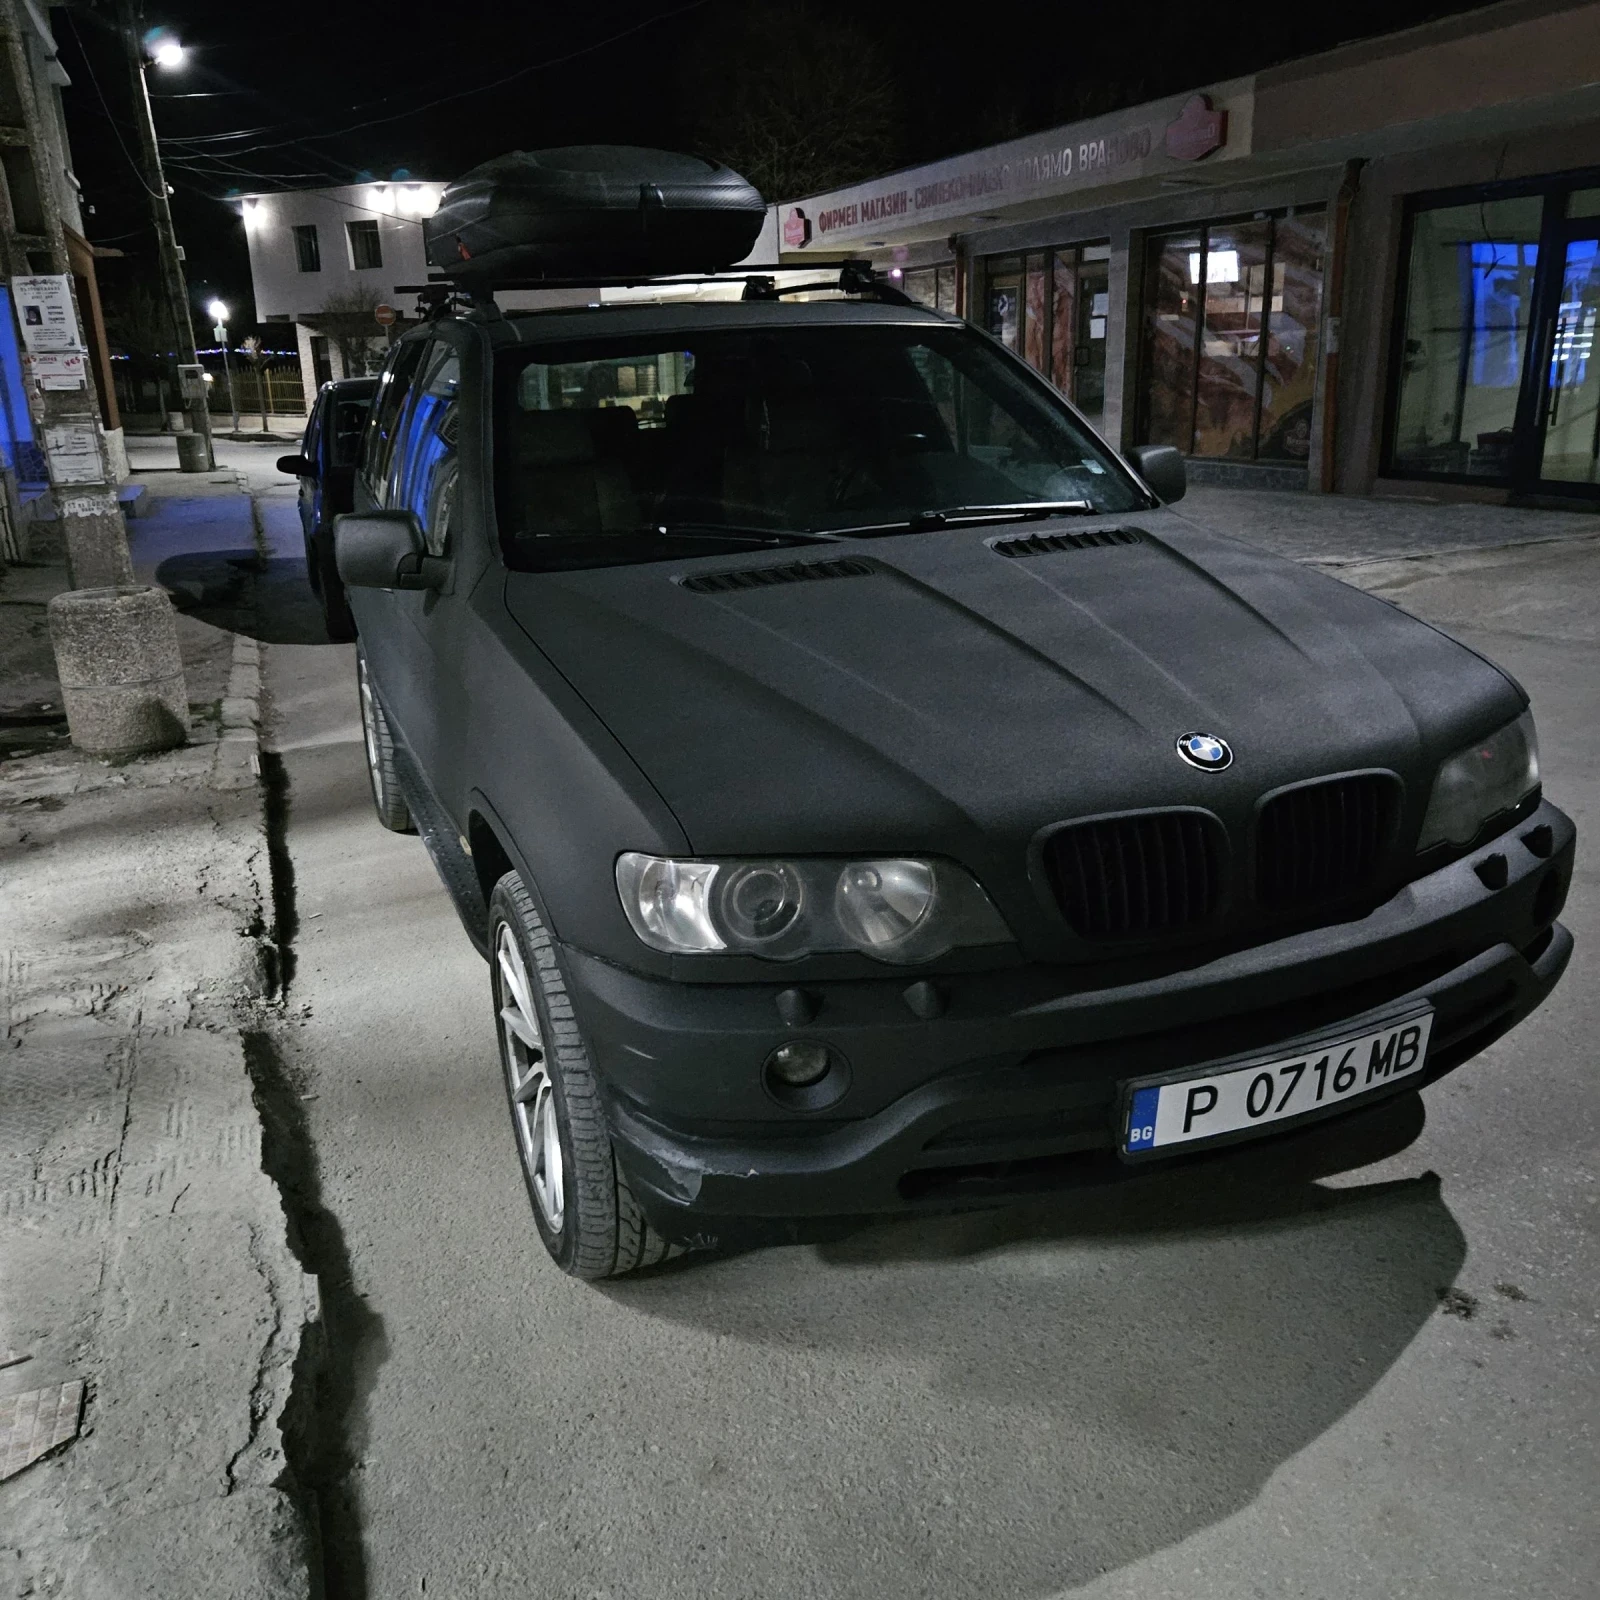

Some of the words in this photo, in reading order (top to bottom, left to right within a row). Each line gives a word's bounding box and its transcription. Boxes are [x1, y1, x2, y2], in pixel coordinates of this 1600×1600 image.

[819, 203, 858, 233] ФИРМЕН
[861, 190, 907, 222] МАГАЗИН
[1246, 1047, 1357, 1118] 0716
[1365, 1025, 1421, 1085] MB
[1130, 1125, 1154, 1143] BG
